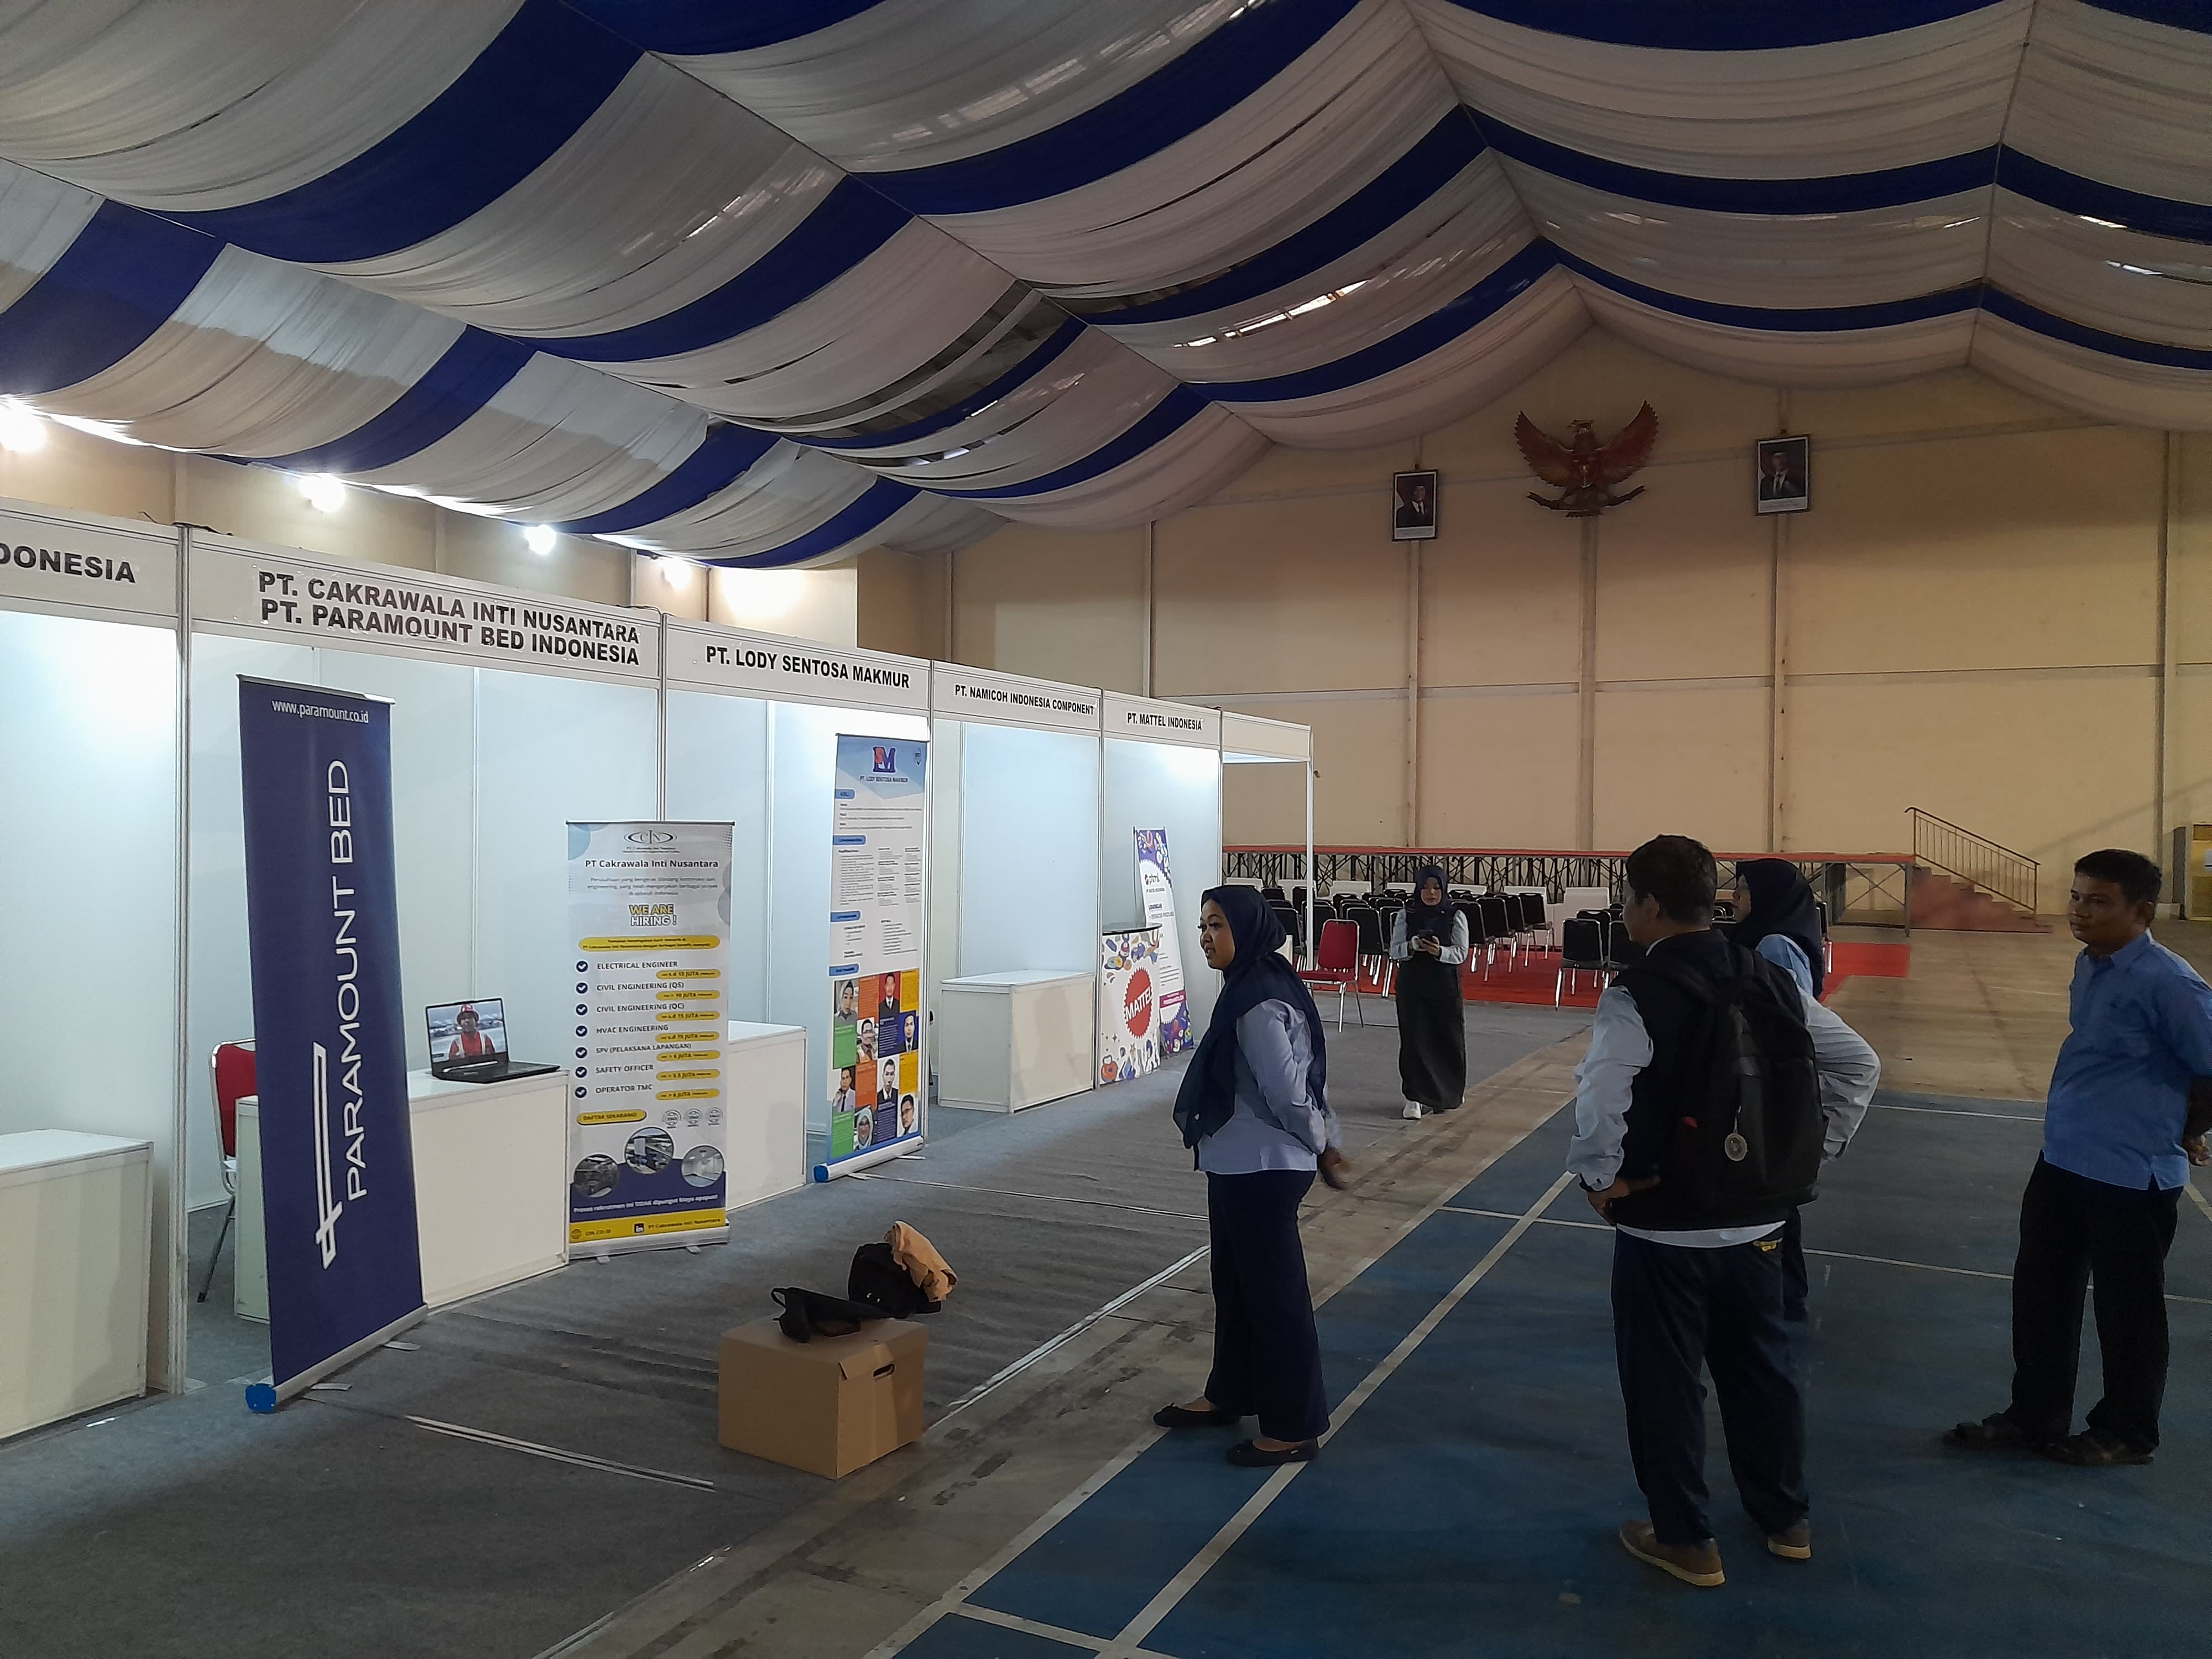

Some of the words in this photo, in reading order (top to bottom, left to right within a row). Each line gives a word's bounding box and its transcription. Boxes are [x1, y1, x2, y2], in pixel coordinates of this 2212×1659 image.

[259, 571, 298, 596] PT.
[308, 578, 465, 618] CAKRAWALA
[473, 602, 515, 625] INTI
[524, 609, 639, 644] NUSANTARA
[262, 599, 301, 624] PT.
[312, 604, 472, 643] PARAMOUNT
[481, 627, 524, 649] BED
[532, 634, 639, 665] INDONESIA
[706, 646, 730, 665] PT.
[736, 649, 778, 670] LODY
[782, 656, 849, 680] SENTOSA
[853, 666, 910, 688] MAKMUR
[272, 700, 369, 724] www.paramount.co.id
[955, 685, 967, 697] PT.
[970, 687, 1008, 702] NAMICOH
[1010, 693, 1051, 708] INDONESIA
[1052, 700, 1094, 715] COMPONENT
[1128, 713, 1138, 724] PT.
[1140, 713, 1166, 727] MATTEL
[1168, 717, 1202, 731] INDONESIA
[328, 760, 353, 863] BED
[629, 904, 648, 915] WE
[651, 904, 674, 915] ARE
[1125, 986, 1152, 1022] MATTEL
[332, 875, 367, 1201] PARAMOUNT
